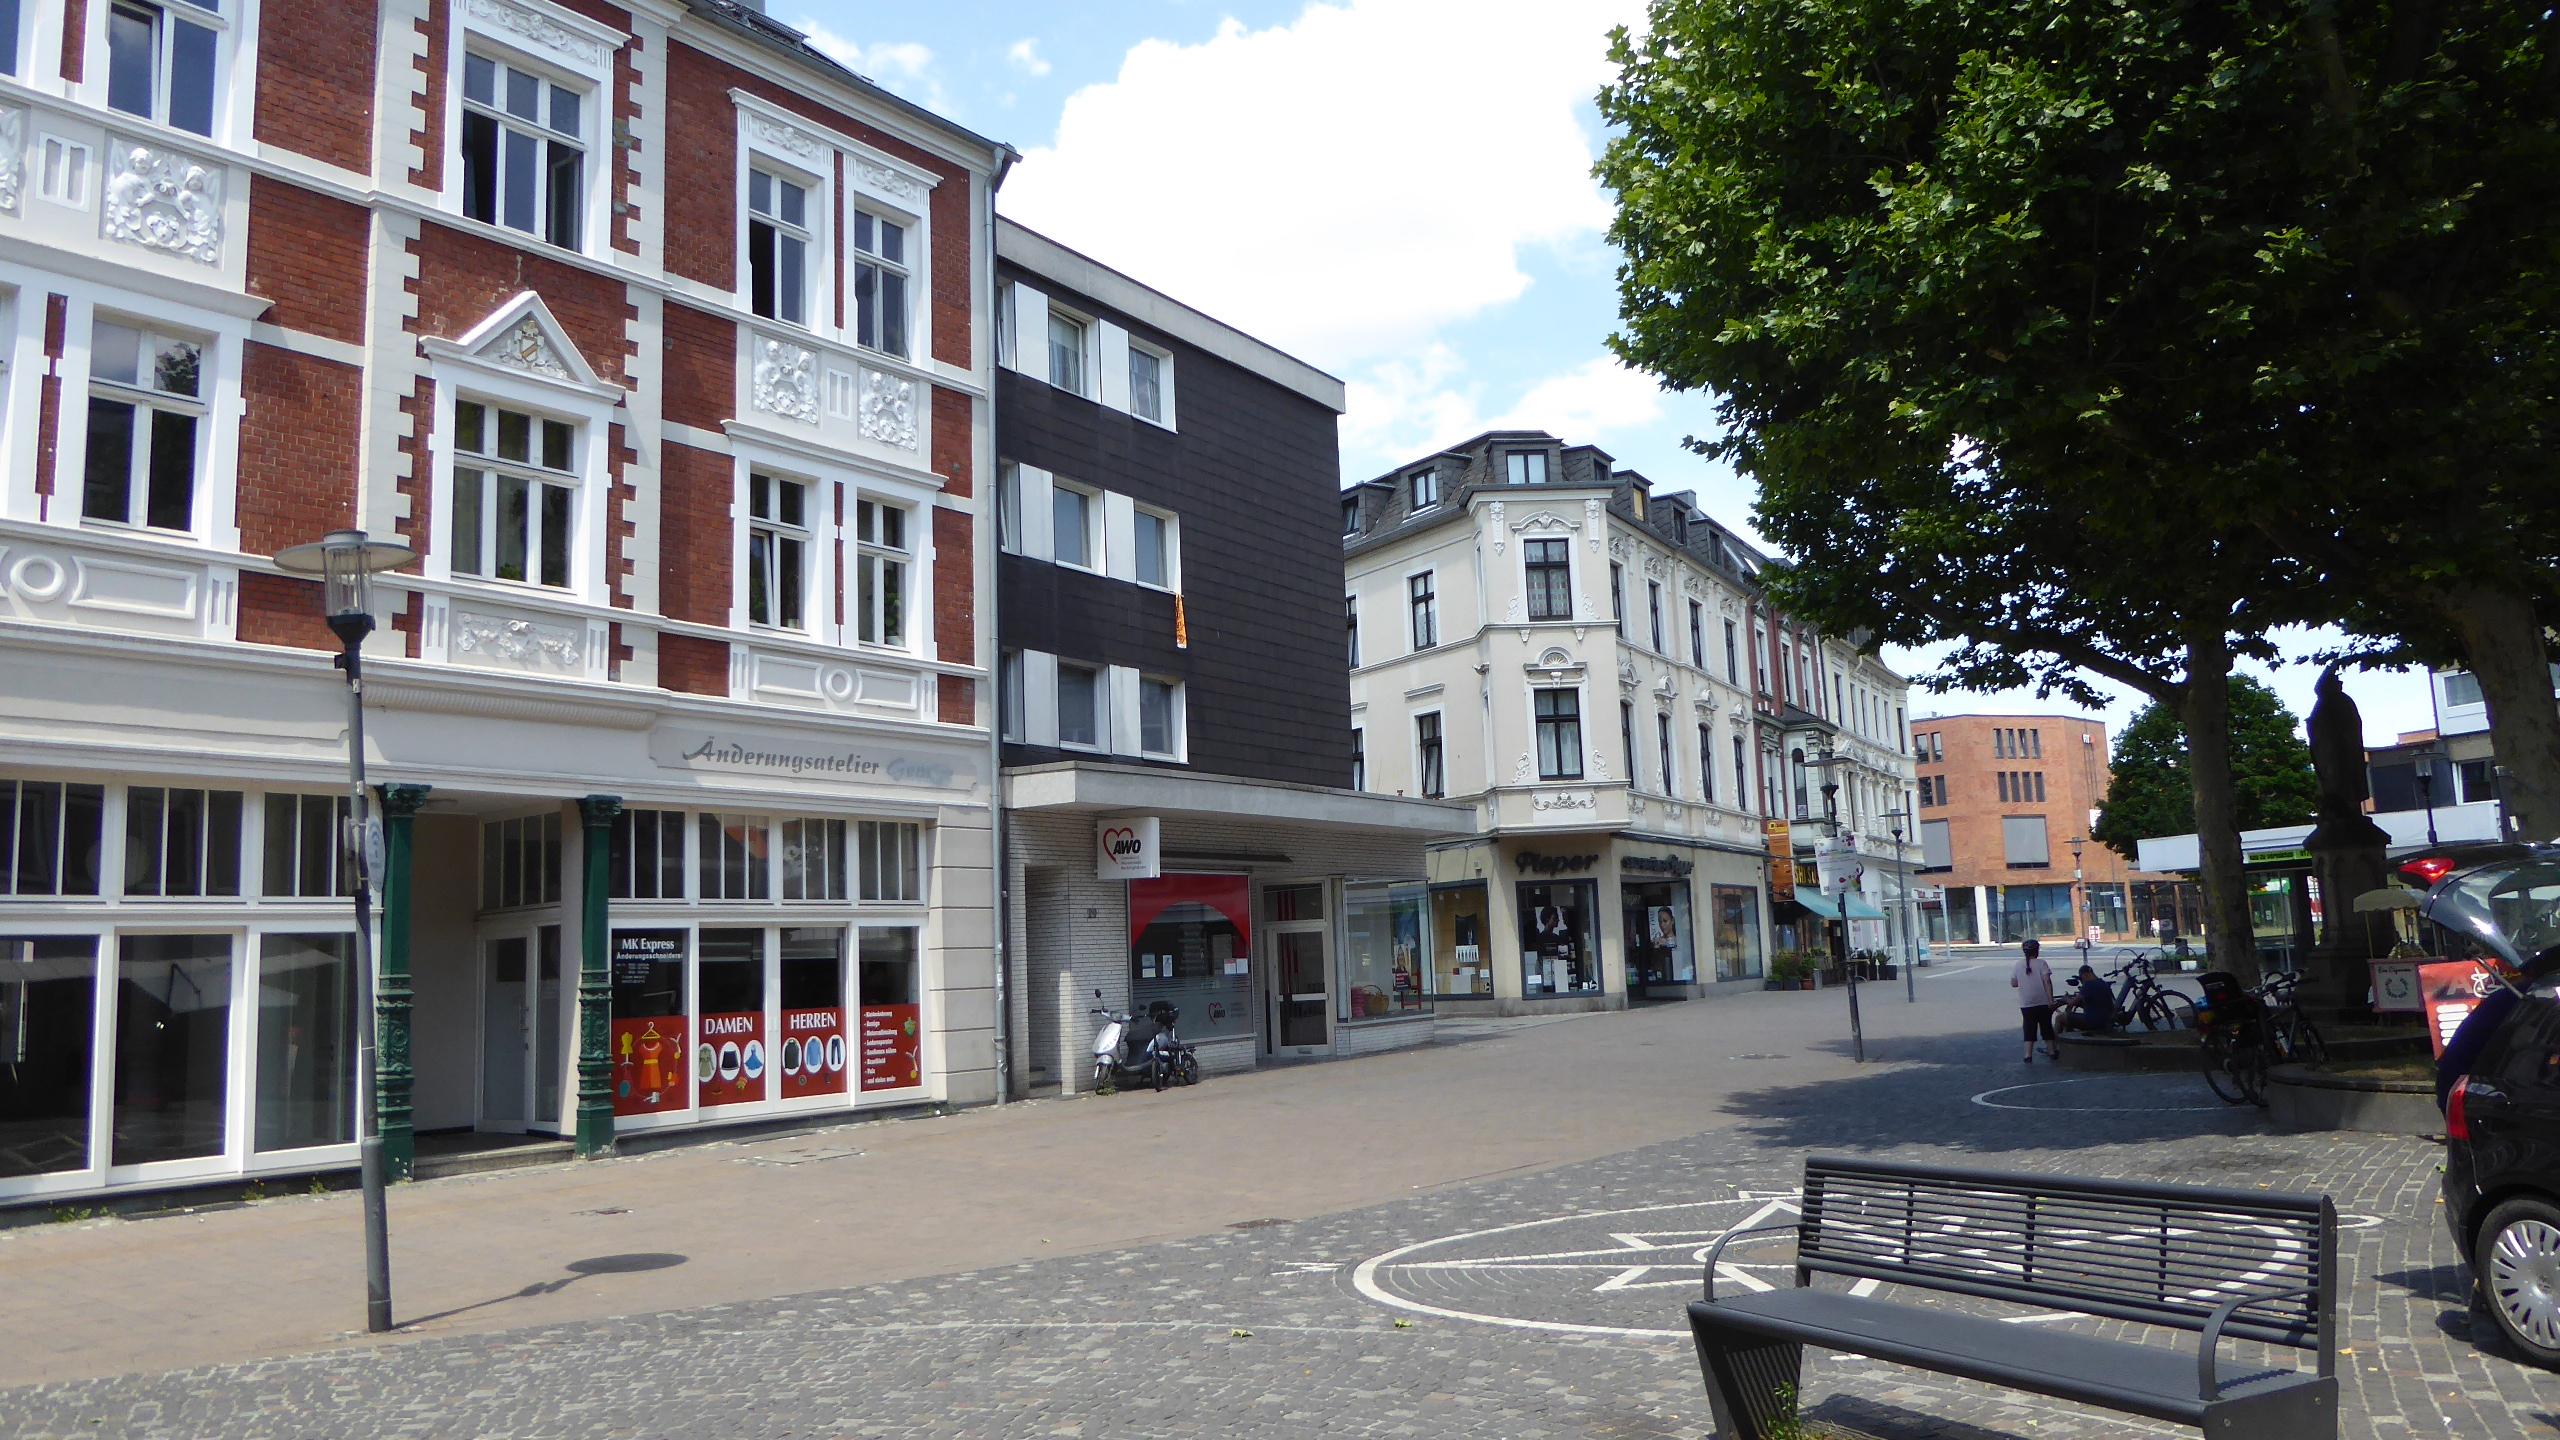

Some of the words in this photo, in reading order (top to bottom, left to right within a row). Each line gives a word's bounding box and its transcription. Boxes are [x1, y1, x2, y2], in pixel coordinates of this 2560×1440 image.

[682, 735, 880, 775] Änderungsatelier
[1112, 838, 1142, 855] AWO
[1515, 850, 1599, 877] Pieper
[621, 938, 639, 950] MK
[641, 937, 675, 953] Express
[705, 1015, 753, 1035] DAMEN
[789, 1011, 837, 1031] HERREN
